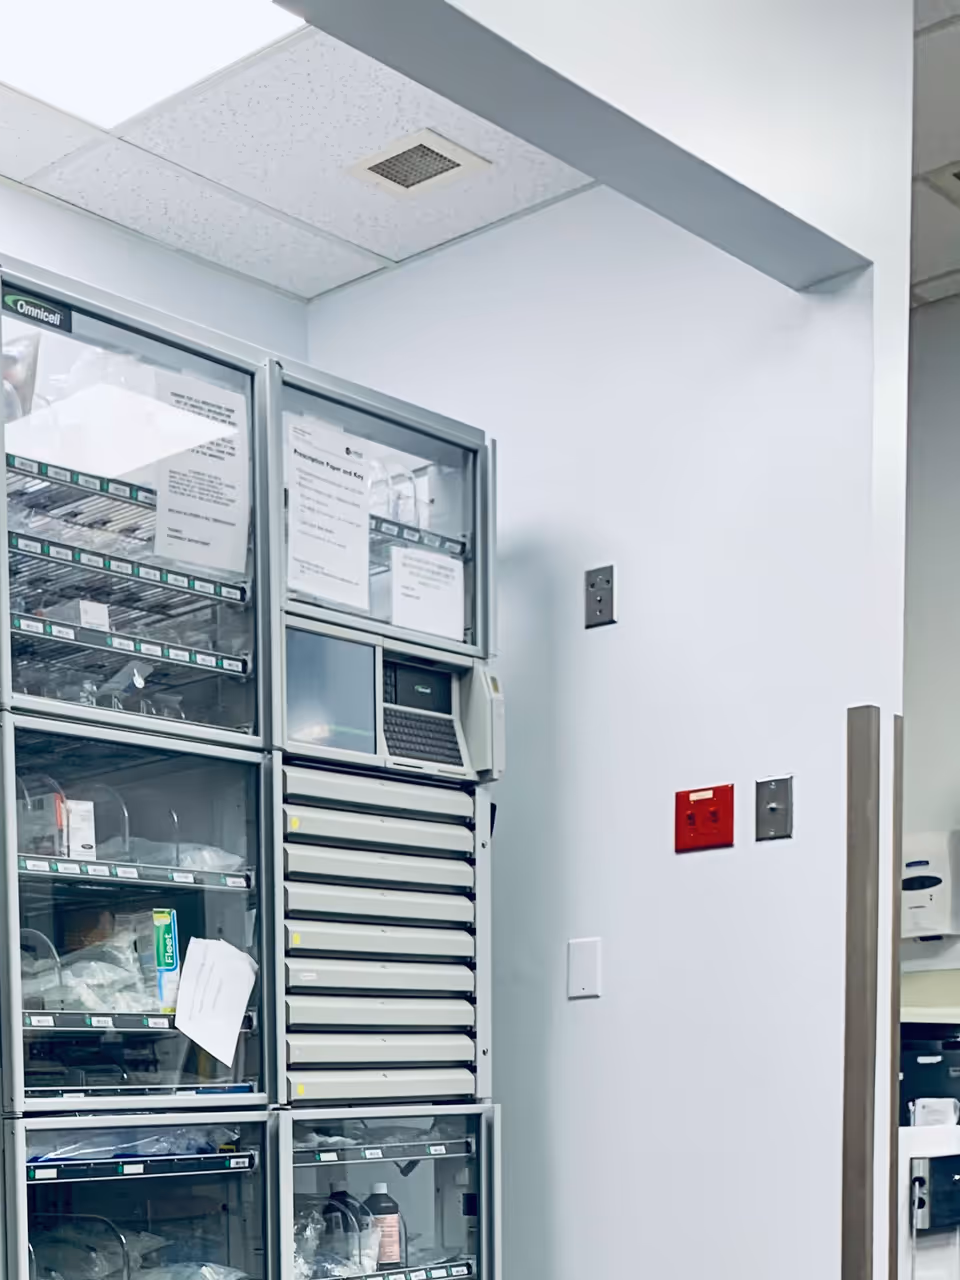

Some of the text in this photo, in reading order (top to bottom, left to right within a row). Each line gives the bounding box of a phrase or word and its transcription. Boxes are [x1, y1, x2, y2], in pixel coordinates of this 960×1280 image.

[17, 300, 61, 326] Omnicell
[353, 472, 364, 481] Key
[165, 933, 173, 963] Fleet
